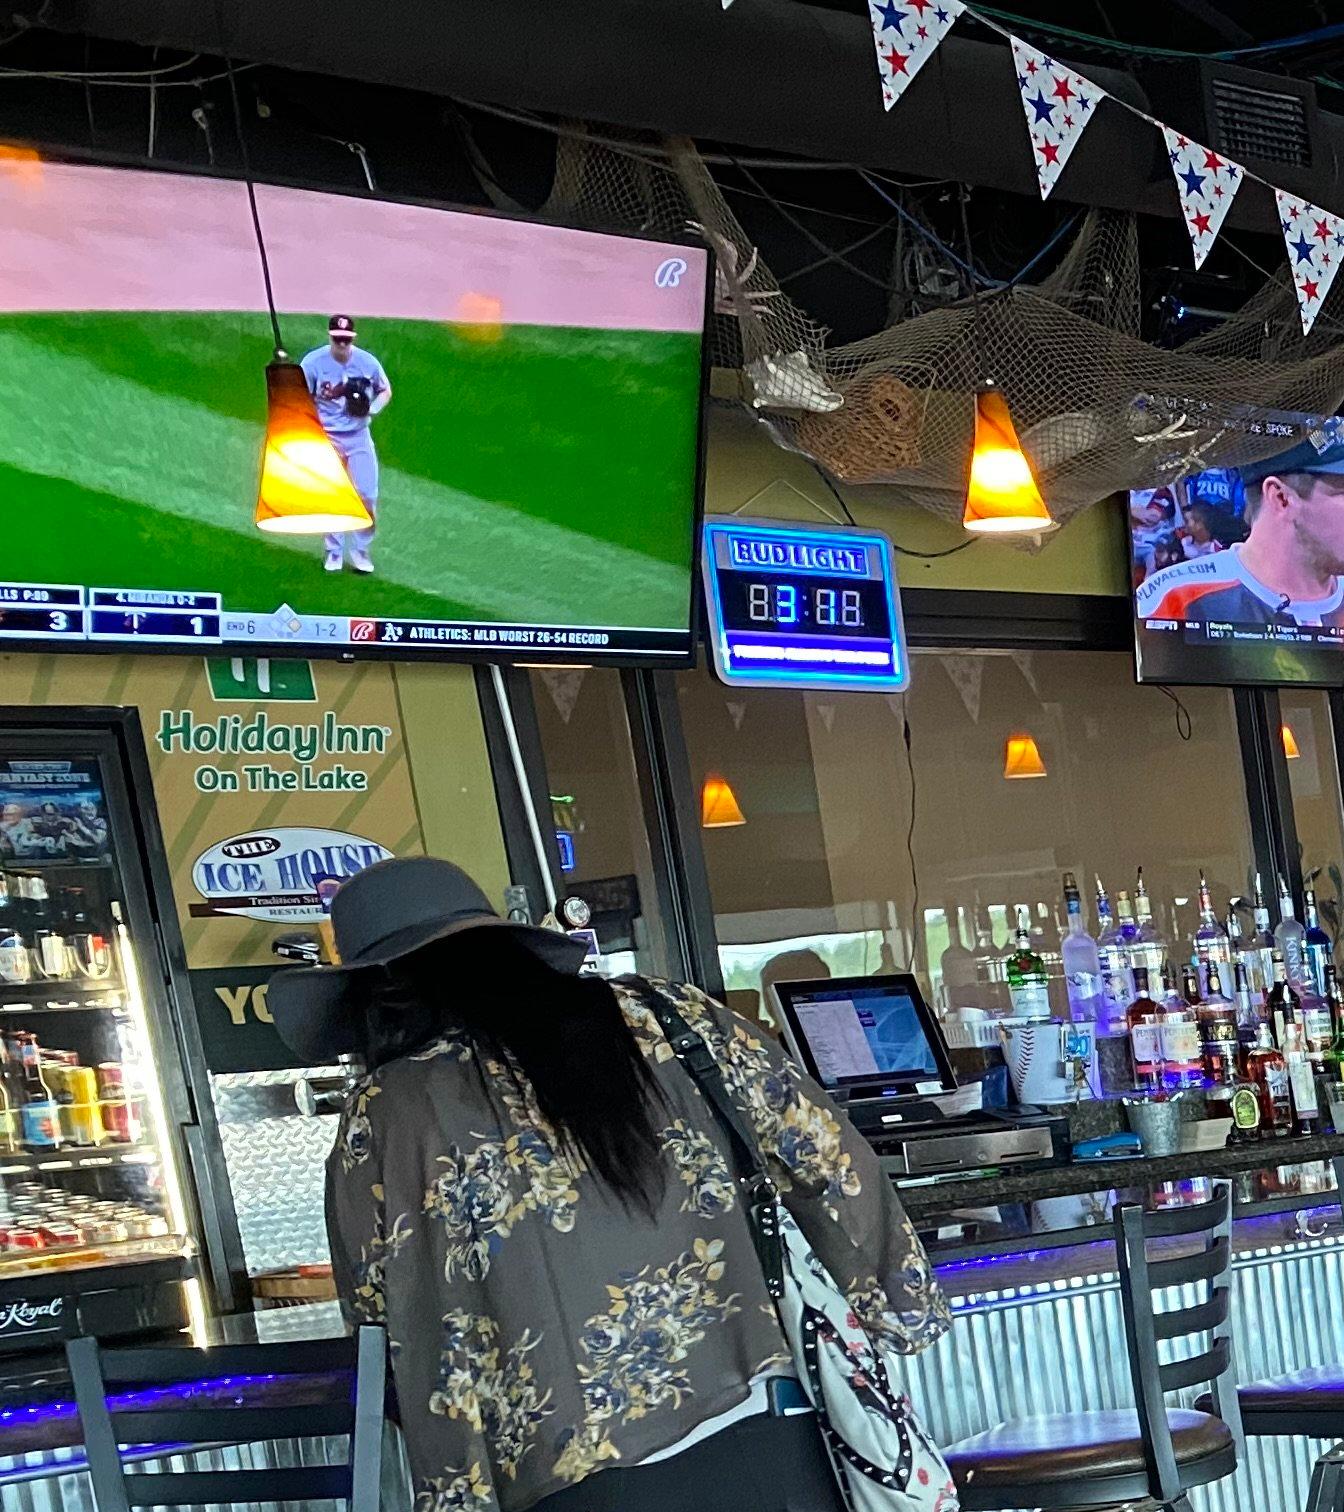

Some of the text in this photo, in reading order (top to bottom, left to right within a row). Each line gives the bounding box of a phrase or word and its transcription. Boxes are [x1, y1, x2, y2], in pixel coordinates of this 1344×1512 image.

[734, 539, 866, 573] BUD LIGHT
[0, 588, 19, 600] LLS
[49, 611, 68, 631] 3
[190, 616, 204, 635] 1
[247, 620, 256, 634] 6
[314, 622, 337, 637] 1-2
[409, 627, 472, 641] ATHLETICS:
[474, 629, 496, 641] MLB
[499, 630, 534, 643] WORST
[536, 631, 567, 643] 26-54
[568, 632, 609, 645] RECORD
[156, 710, 387, 763] Holiday Inn
[195, 765, 368, 792] On The Lake
[223, 837, 277, 857] THE
[201, 863, 267, 892] ICE
[250, 896, 301, 907] Tradition
[268, 907, 323, 917] RESTAUR
